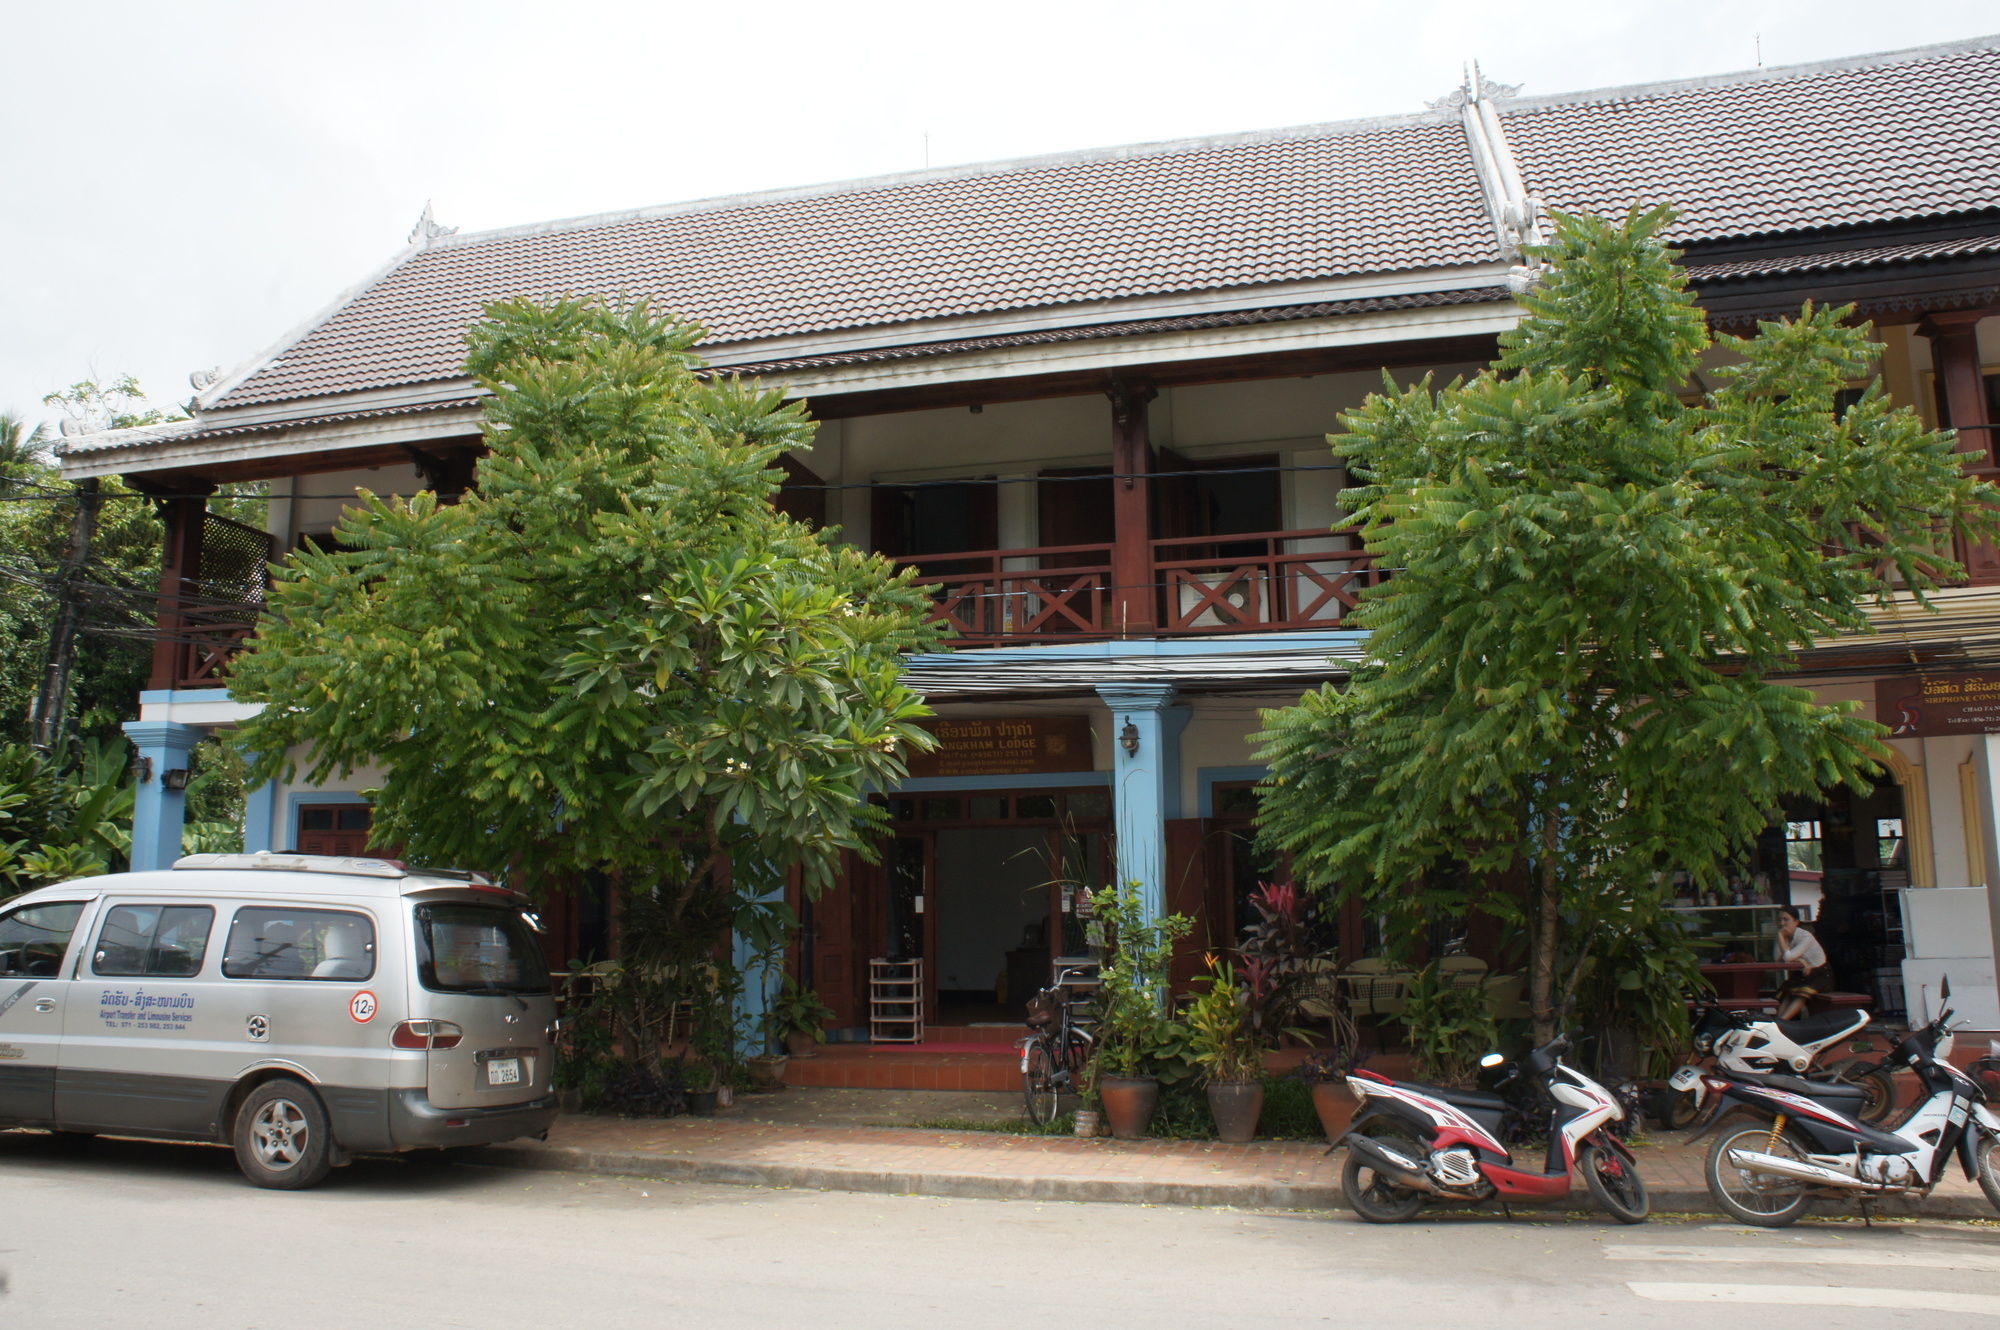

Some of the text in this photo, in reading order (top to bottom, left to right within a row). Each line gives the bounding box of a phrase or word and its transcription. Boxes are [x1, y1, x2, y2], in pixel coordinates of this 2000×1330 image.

[1924, 695, 1971, 704] SIRIPHONE
[942, 738, 1037, 751] ANGKHAM LODGE
[100, 1009, 192, 1022] Airport Transfer and Limousine Services
[501, 1069, 518, 1082] 2654
